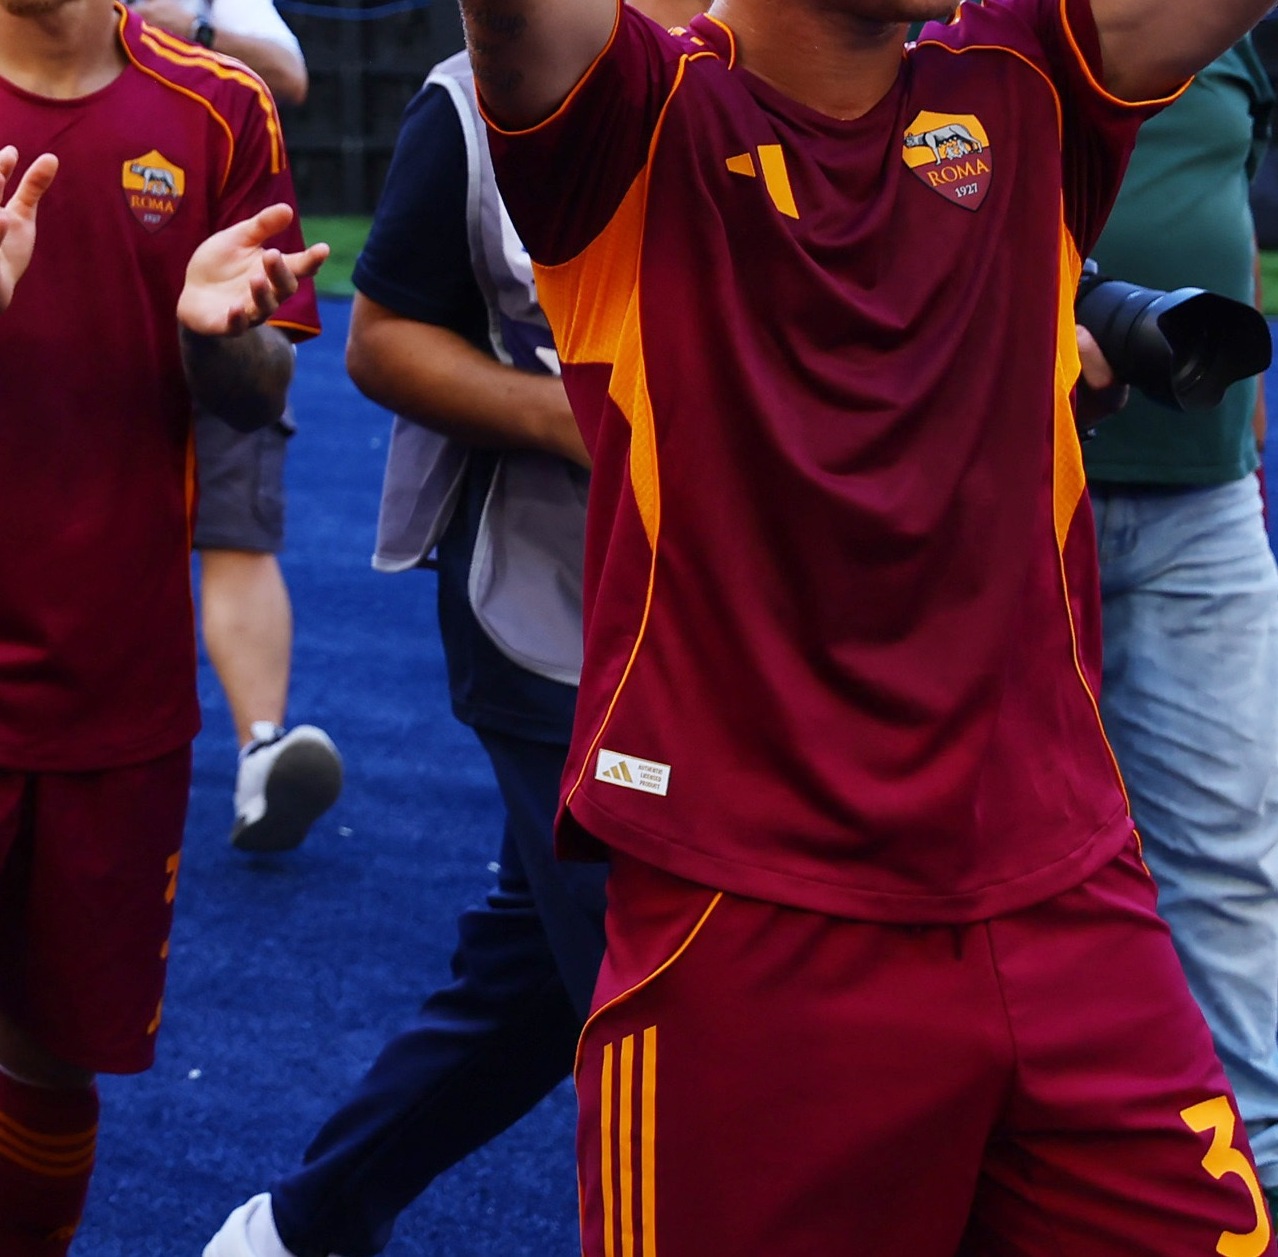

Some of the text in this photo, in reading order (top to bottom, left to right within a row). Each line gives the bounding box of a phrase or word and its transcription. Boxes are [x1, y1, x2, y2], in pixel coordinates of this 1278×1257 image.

[926, 158, 991, 187] ROMA
[954, 182, 979, 198] 1927
[130, 194, 175, 214] ROMA
[1179, 1095, 1271, 1257] 3
